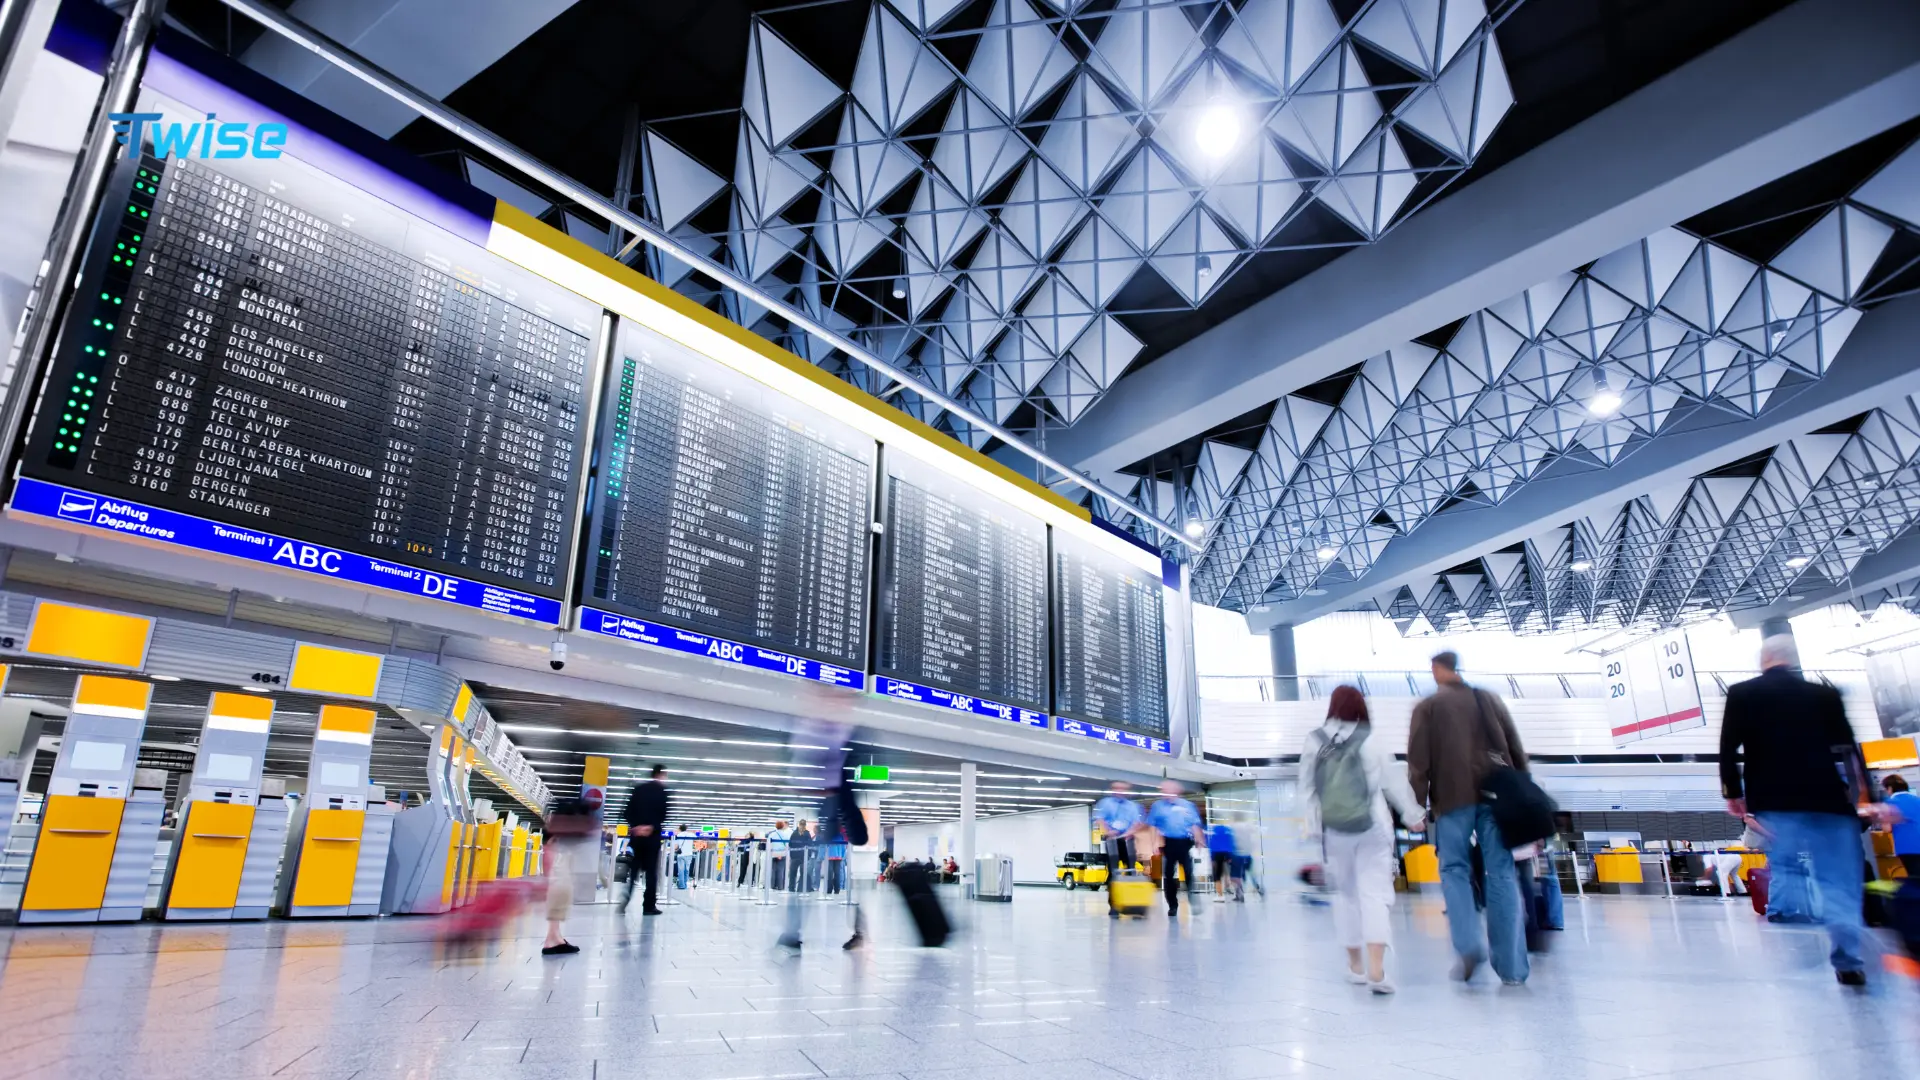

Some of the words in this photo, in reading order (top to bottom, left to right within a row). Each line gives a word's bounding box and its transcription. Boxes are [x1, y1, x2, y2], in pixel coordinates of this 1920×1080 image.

[210, 187, 244, 207] 3102
[262, 209, 326, 243] HELSINKI
[214, 175, 247, 196] 2188
[265, 198, 328, 232] VARADERO
[213, 213, 238, 230] 462
[256, 231, 297, 255] MIAMI
[216, 202, 241, 219] 468
[259, 220, 323, 253] PORTLAND
[197, 233, 232, 253] 3236
[250, 254, 283, 274] IEW
[196, 272, 223, 288] 494
[241, 289, 299, 317] CALGARY
[193, 284, 220, 300] 875
[238, 301, 305, 332] MONTREAL
[183, 321, 210, 337] 442
[228, 337, 288, 364] DETROIT
[186, 308, 213, 325] 456
[232, 325, 257, 340] LOS
[266, 337, 323, 363] ANGELES
[179, 333, 206, 349] 440
[225, 349, 285, 376] HOUSTON
[166, 343, 203, 362] 4726
[222, 361, 347, 409] LONDON-HEATHROW
[169, 371, 196, 387] 417
[215, 386, 268, 409] ZAGREB
[155, 381, 193, 400] 6808
[212, 398, 256, 419] KOELN
[265, 415, 290, 429] HBF
[161, 397, 190, 412] 686
[209, 411, 236, 426] TEL
[245, 422, 279, 439] AVIV
[154, 423, 183, 438] 176
[202, 437, 307, 473] BERLIN-TEGEL
[158, 410, 186, 425] 590
[205, 424, 250, 444] ADDIS
[259, 439, 372, 479] ABEBA-KHARTOUM
[137, 447, 176, 465] 4980
[195, 463, 250, 484] DUBLIN
[150, 436, 179, 452] 117
[199, 449, 279, 479] LJUBLJANA
[133, 461, 172, 478] 3126
[192, 476, 247, 497] BERGEN
[129, 474, 168, 492] 3160
[188, 489, 270, 517] STAVANGER
[100, 500, 149, 521] Abflug
[96, 513, 176, 539] Departures
[213, 525, 266, 546] Terminal
[268, 538, 274, 547] 1
[273, 541, 342, 573] ABC
[667, 557, 699, 573] VILNIUS
[369, 561, 413, 579] Terminal
[414, 572, 421, 581] 2
[666, 567, 698, 582] TORONTO
[423, 574, 459, 599] DE
[664, 576, 702, 593] HELSINKI
[661, 605, 690, 619] DUBLIN
[662, 596, 718, 616] POZNAN/POSEN
[619, 628, 658, 643] Departures
[620, 620, 645, 632] Abflug
[676, 631, 703, 644] Terminal
[707, 640, 743, 661] ABC
[757, 650, 782, 662] Terminal
[1663, 640, 1679, 657] 10
[786, 657, 806, 675] DE
[1607, 661, 1622, 678] 20
[1667, 663, 1684, 679] 10
[950, 695, 973, 711] ABC
[1611, 683, 1625, 698] 20
[1000, 706, 1012, 720] DE
[1105, 729, 1120, 742] ABC
